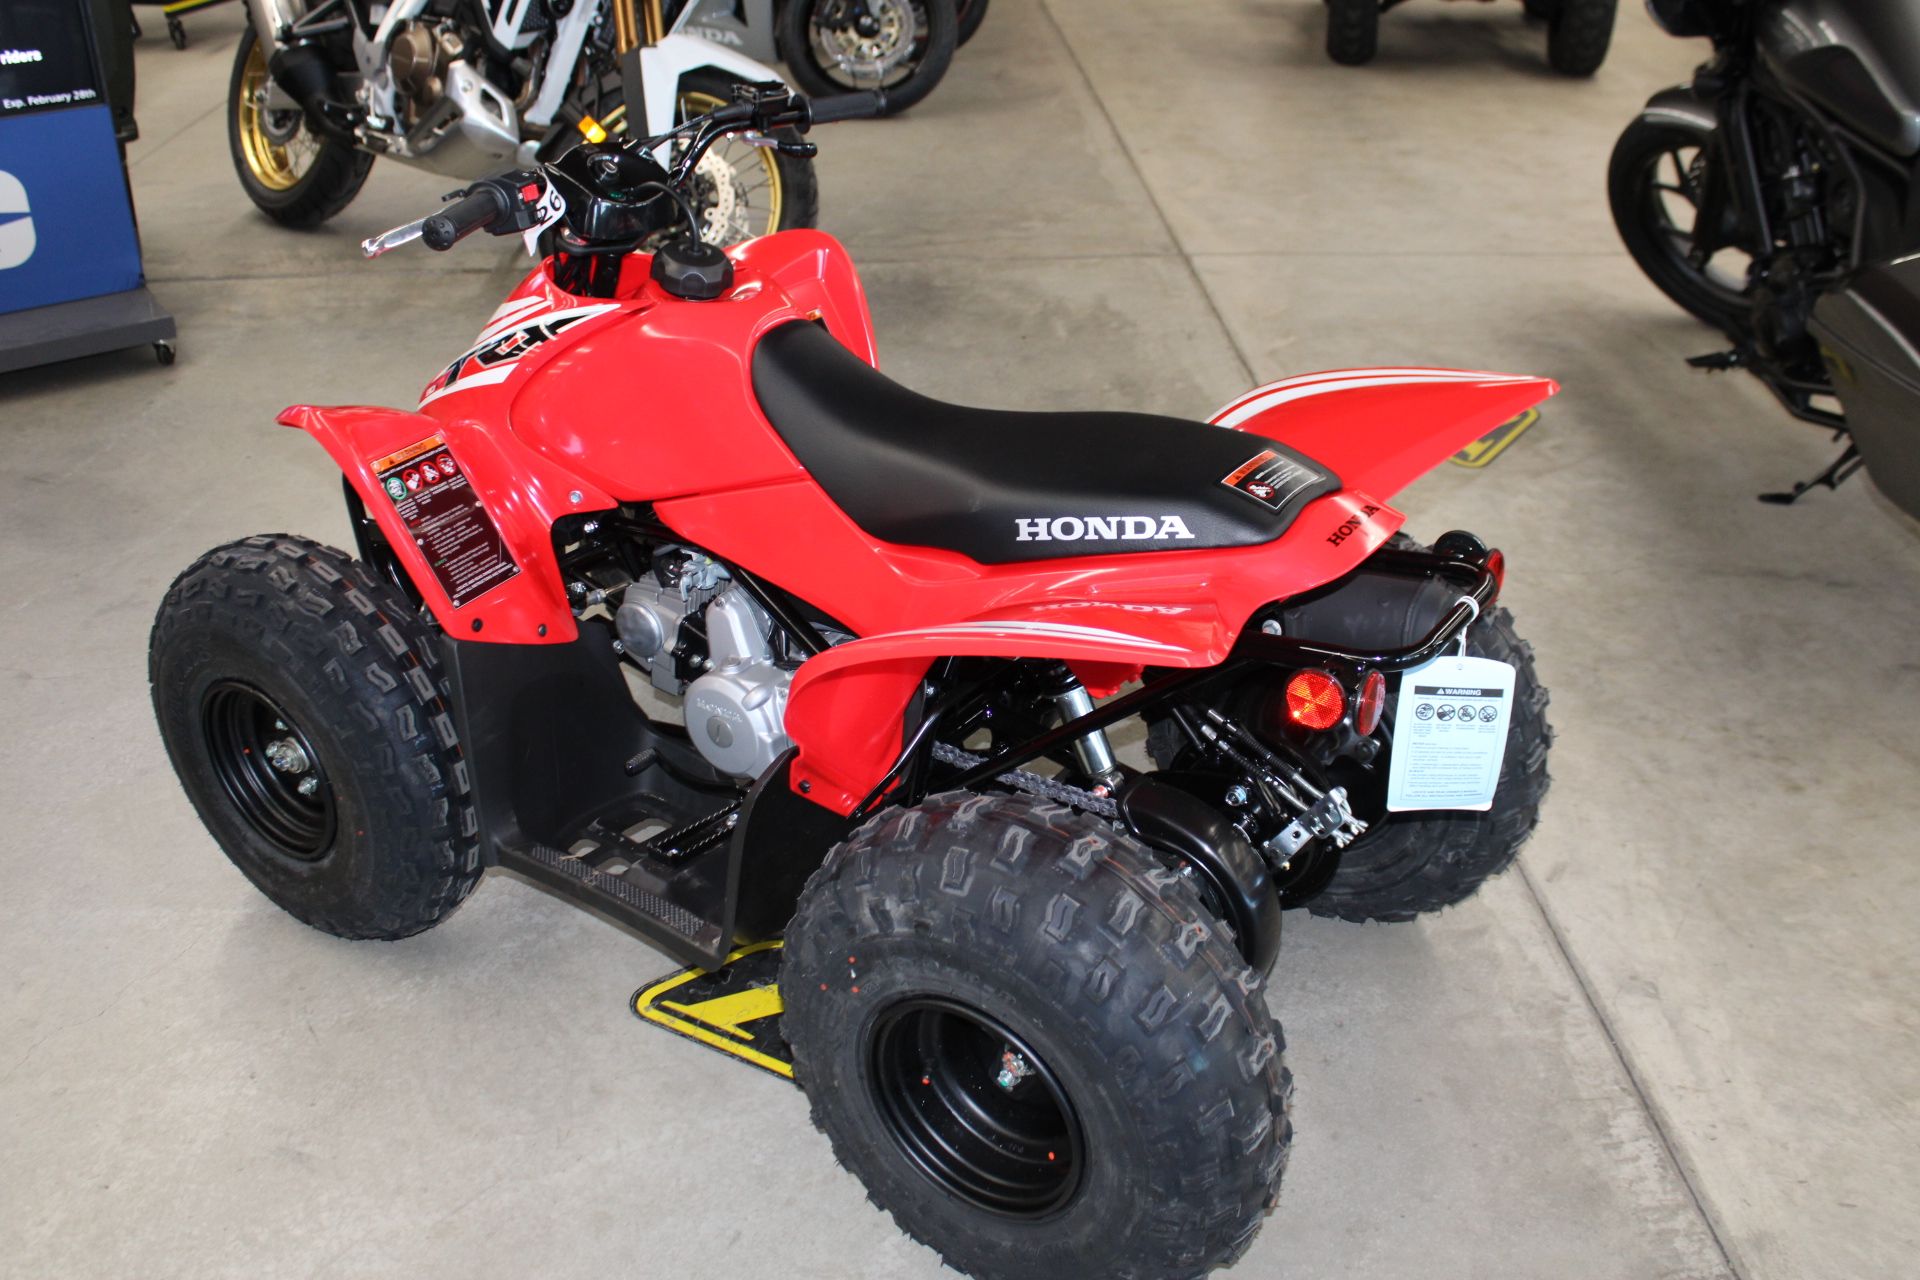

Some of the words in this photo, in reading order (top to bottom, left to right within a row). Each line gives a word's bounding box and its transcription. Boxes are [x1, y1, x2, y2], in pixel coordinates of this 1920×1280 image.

[3, 99, 26, 110] Exp.
[27, 93, 72, 104] February
[72, 89, 96, 101] 28th
[1015, 515, 1195, 541] HONDA
[1445, 688, 1482, 696] WARNING
